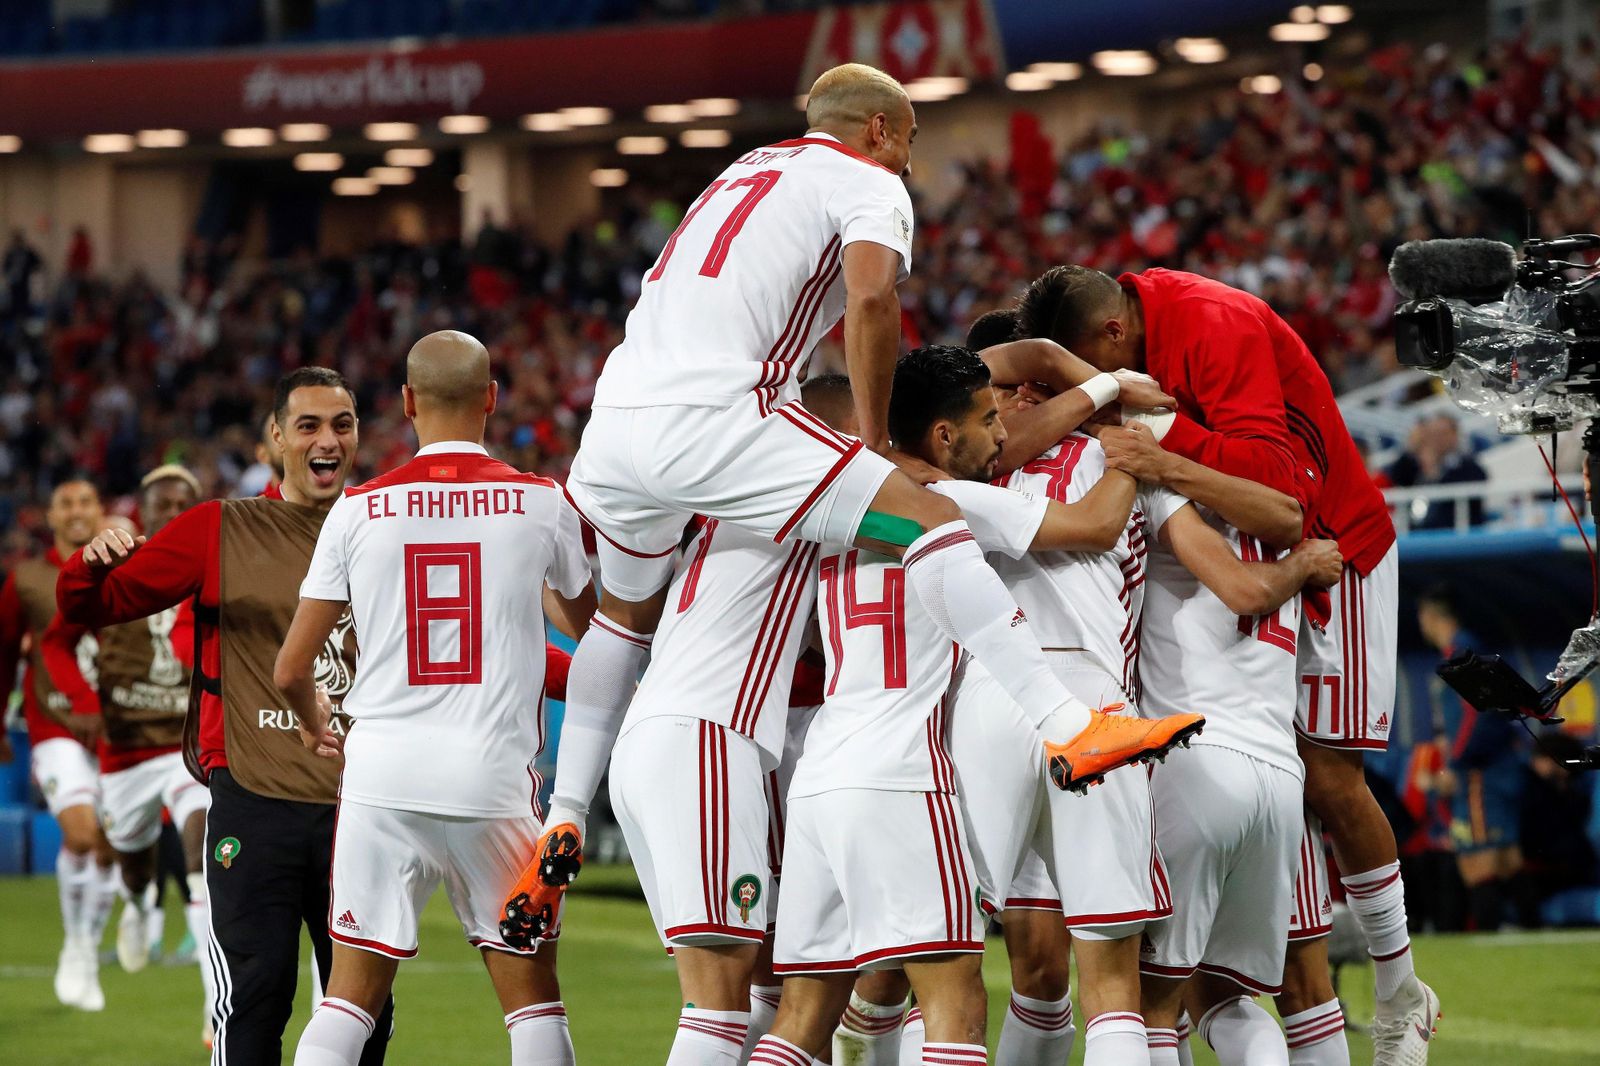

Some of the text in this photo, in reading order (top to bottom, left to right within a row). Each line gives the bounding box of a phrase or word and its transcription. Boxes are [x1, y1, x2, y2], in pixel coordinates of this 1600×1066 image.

[367, 488, 526, 520] EL AHMADI
[403, 541, 483, 687] 8
[819, 548, 908, 697] 14
[258, 708, 346, 737] RUA
[1301, 674, 1341, 734] 11
[336, 920, 361, 932] adidas
